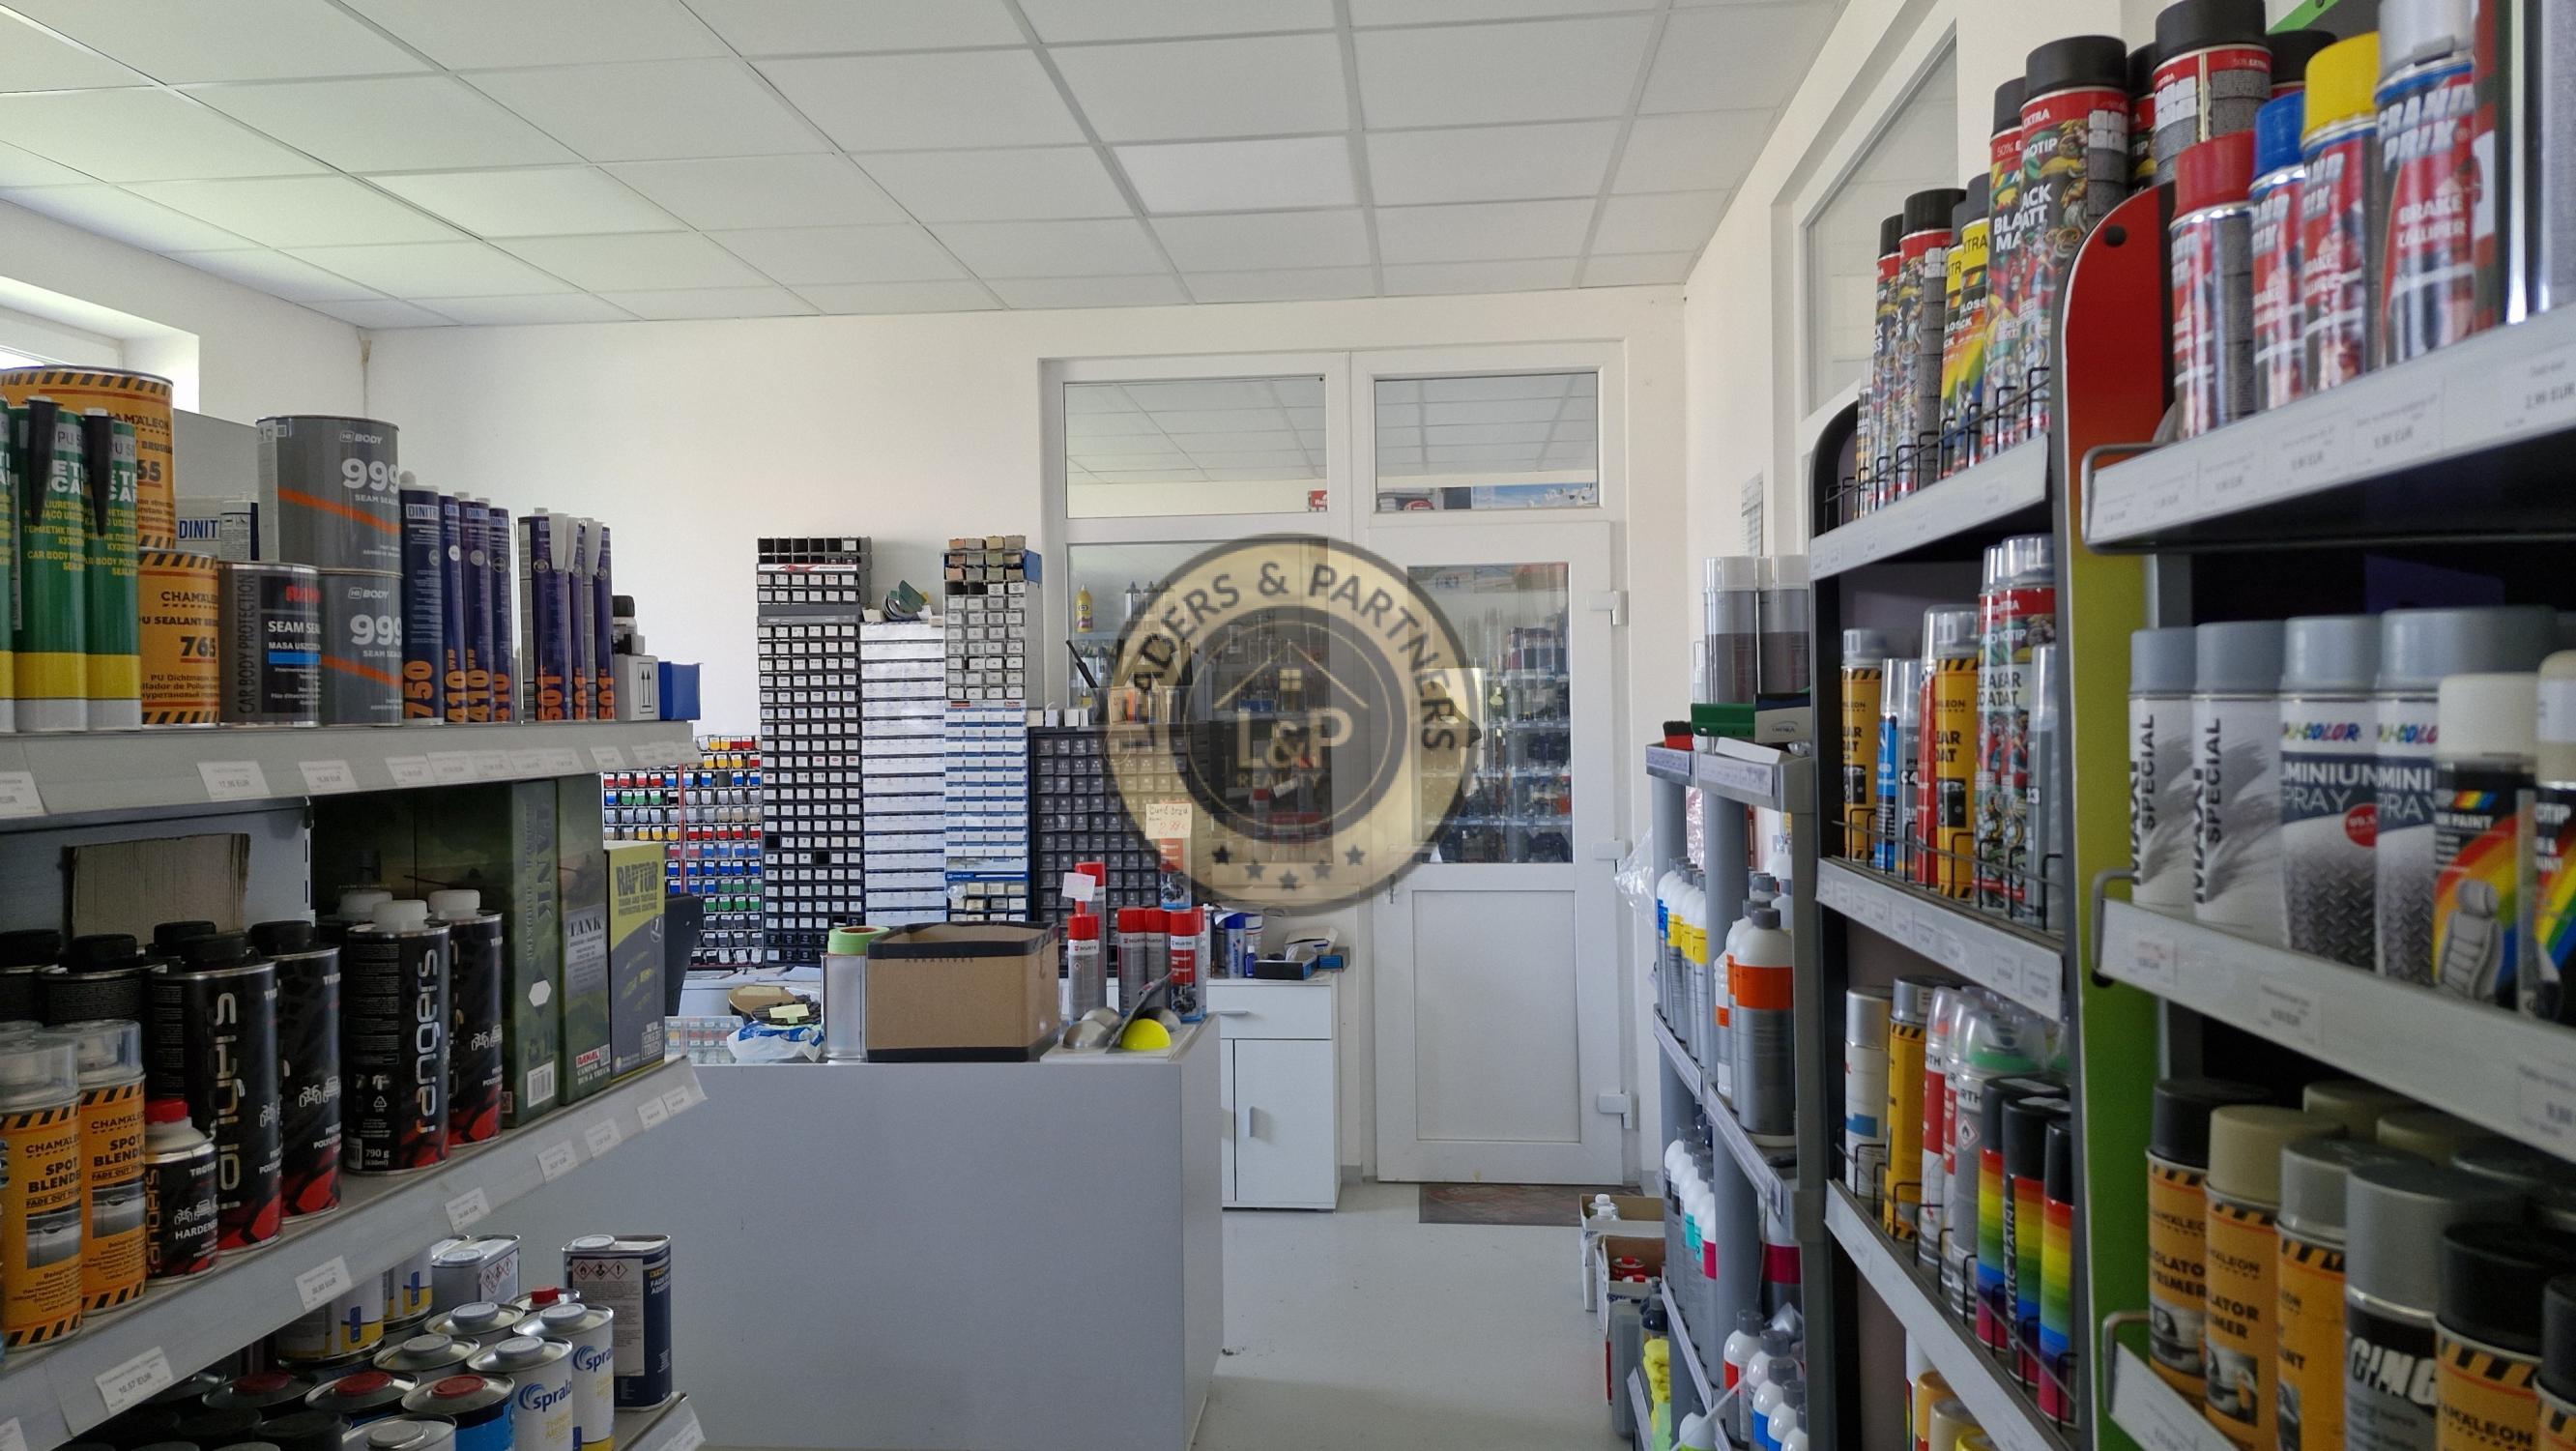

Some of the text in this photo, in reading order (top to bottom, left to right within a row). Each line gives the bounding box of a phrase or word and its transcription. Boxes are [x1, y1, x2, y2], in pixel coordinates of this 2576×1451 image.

[354, 432, 384, 445] BODY
[407, 505, 438, 518] DINIT
[178, 519, 219, 539] DINIT
[362, 588, 389, 599] BODY
[154, 615, 202, 626] SEALANT
[267, 620, 305, 634] SEAM
[238, 574, 255, 713] CAR BODY PROTECTION
[402, 660, 434, 719] 750
[2140, 713, 2156, 831] SPECIAL
[2205, 717, 2222, 845] SPECIAL
[2282, 786, 2352, 814] PRAY
[2535, 801, 2572, 825] OTIP
[616, 860, 658, 897] RAPTOR
[568, 915, 602, 938] TANK
[416, 948, 441, 1134] rangers
[1959, 1089, 1982, 1104] RTH
[109, 1134, 141, 1151] SPOT
[364, 1147, 382, 1158] 790
[45, 1156, 78, 1175] SPOT
[533, 1378, 572, 1412] sprala
